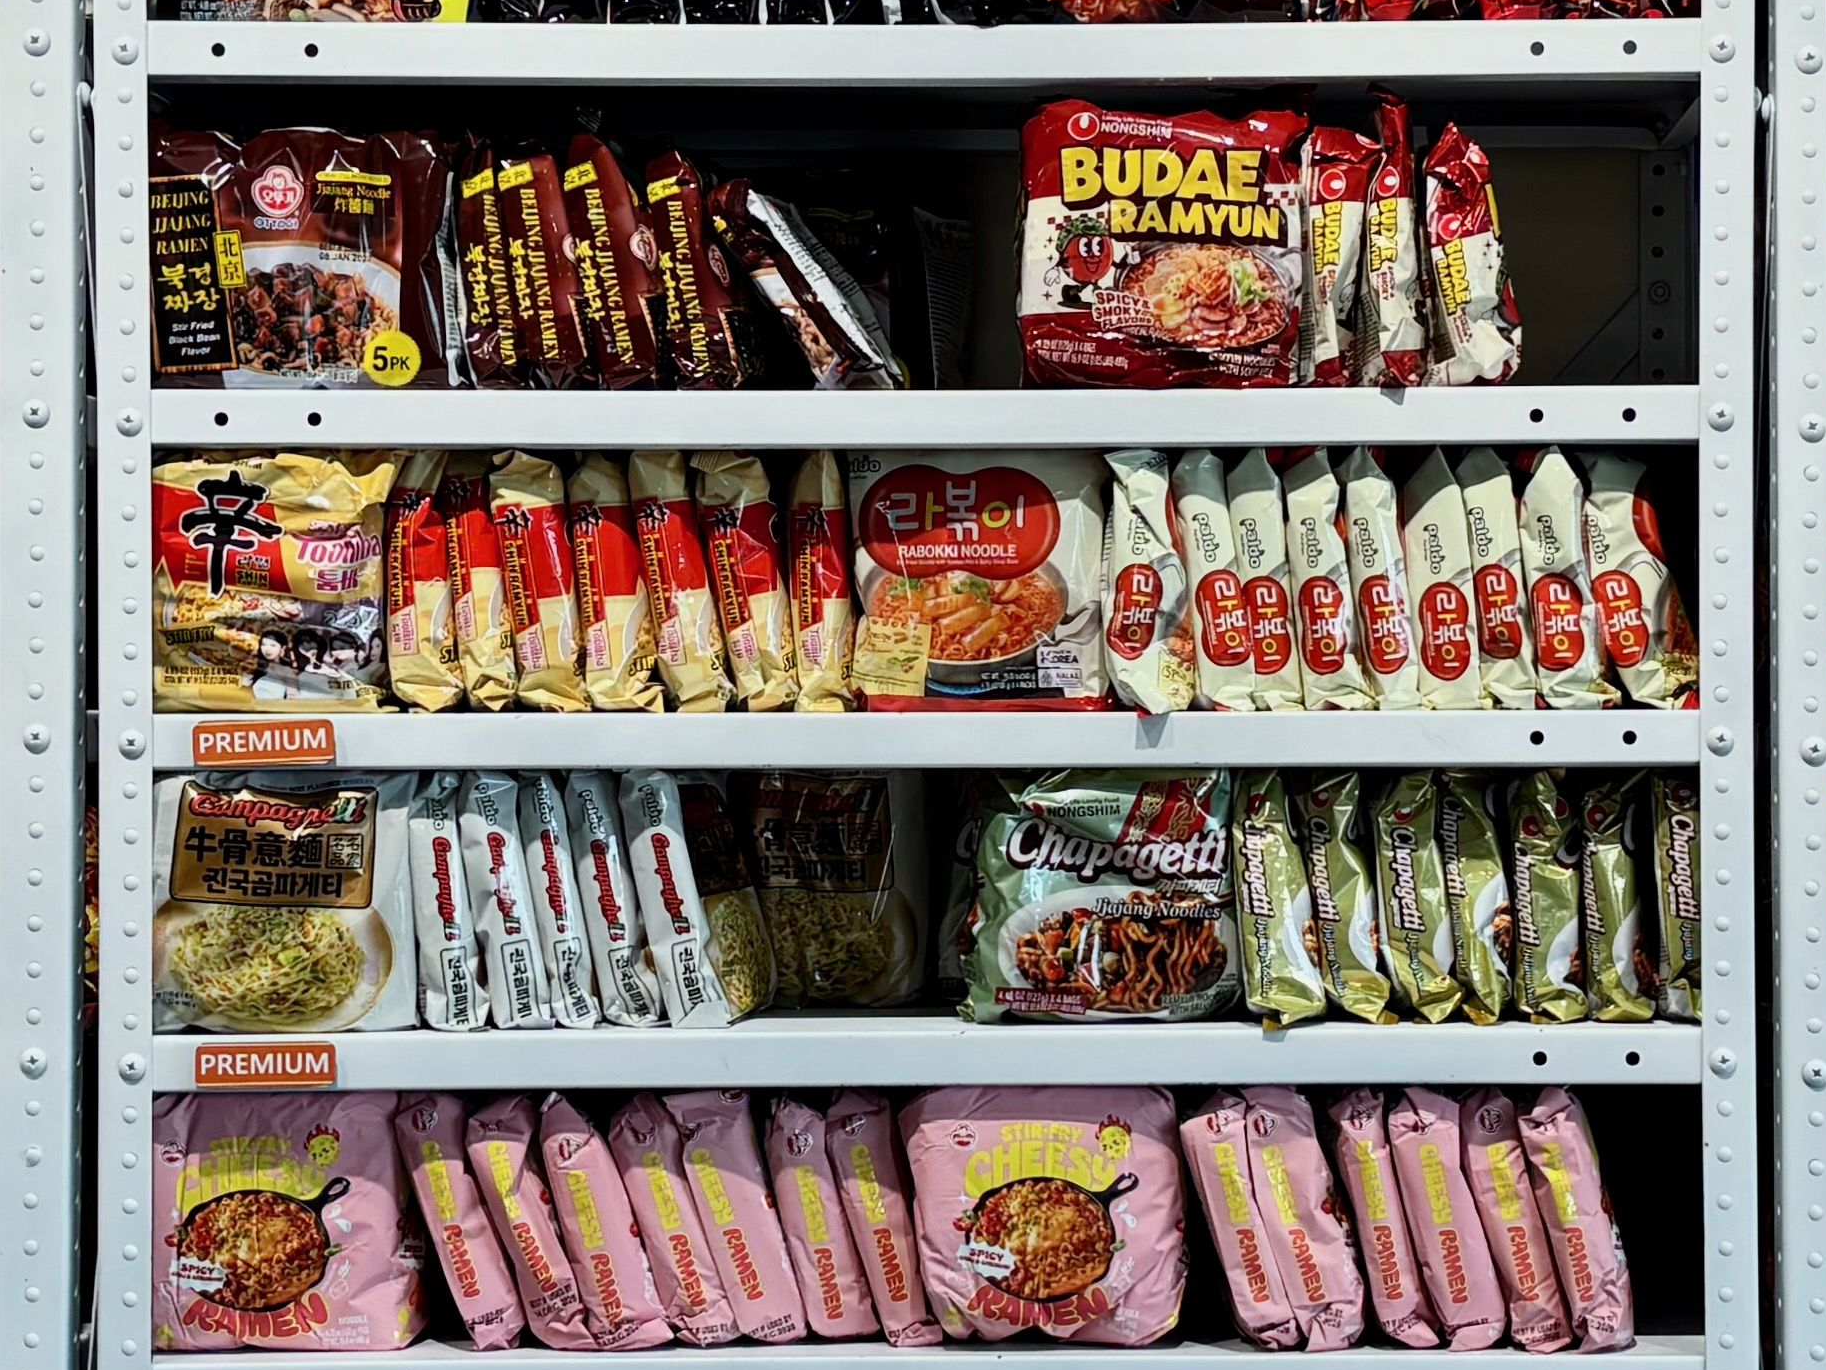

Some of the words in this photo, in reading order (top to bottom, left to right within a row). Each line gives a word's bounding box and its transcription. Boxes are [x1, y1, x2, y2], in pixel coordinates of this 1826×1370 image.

[1098, 120, 1172, 138] NONGSHIM
[1059, 147, 1265, 204] BUDAE
[149, 189, 209, 211] BEIJING
[153, 213, 211, 235] JJAJANG
[1109, 199, 1282, 242] RAMYUN
[155, 234, 209, 257] RAMEN
[1094, 289, 1136, 308] SPICY
[1093, 305, 1140, 320] SMOKY
[886, 478, 1029, 539] 라볶이
[898, 543, 957, 560] RABOKKI
[958, 542, 1018, 558] NOODLE
[197, 726, 328, 755] PREMIUM
[1045, 803, 1123, 819] NONGSHIM
[1005, 816, 1229, 880] Chapagetti
[202, 866, 343, 899] 진국곰파게티
[1093, 896, 1154, 922] Jjajang
[1155, 900, 1223, 921] Noodles
[199, 1053, 331, 1077] PREMIUM
[963, 1144, 1117, 1195] CHEESY
